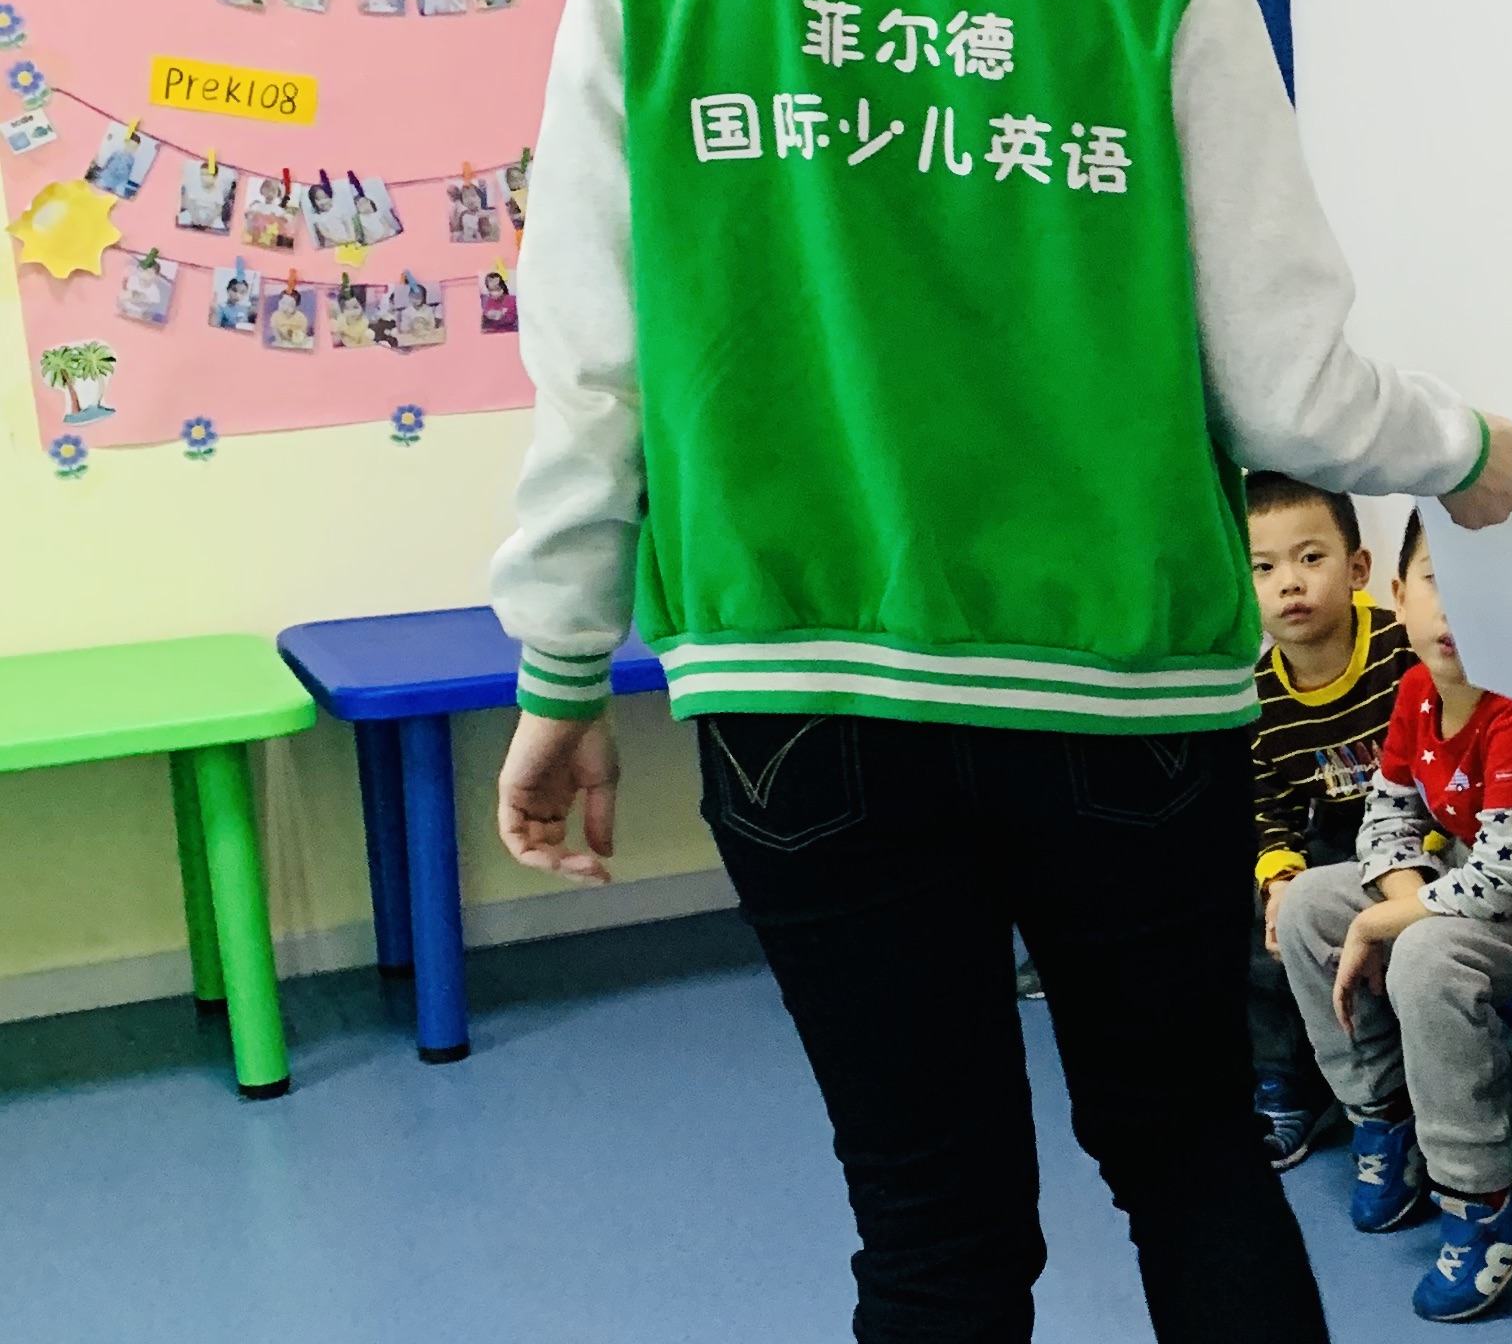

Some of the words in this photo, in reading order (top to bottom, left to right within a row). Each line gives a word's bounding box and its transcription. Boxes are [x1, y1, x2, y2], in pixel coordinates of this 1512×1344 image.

[690, 93, 1133, 194] 国际少儿英语
